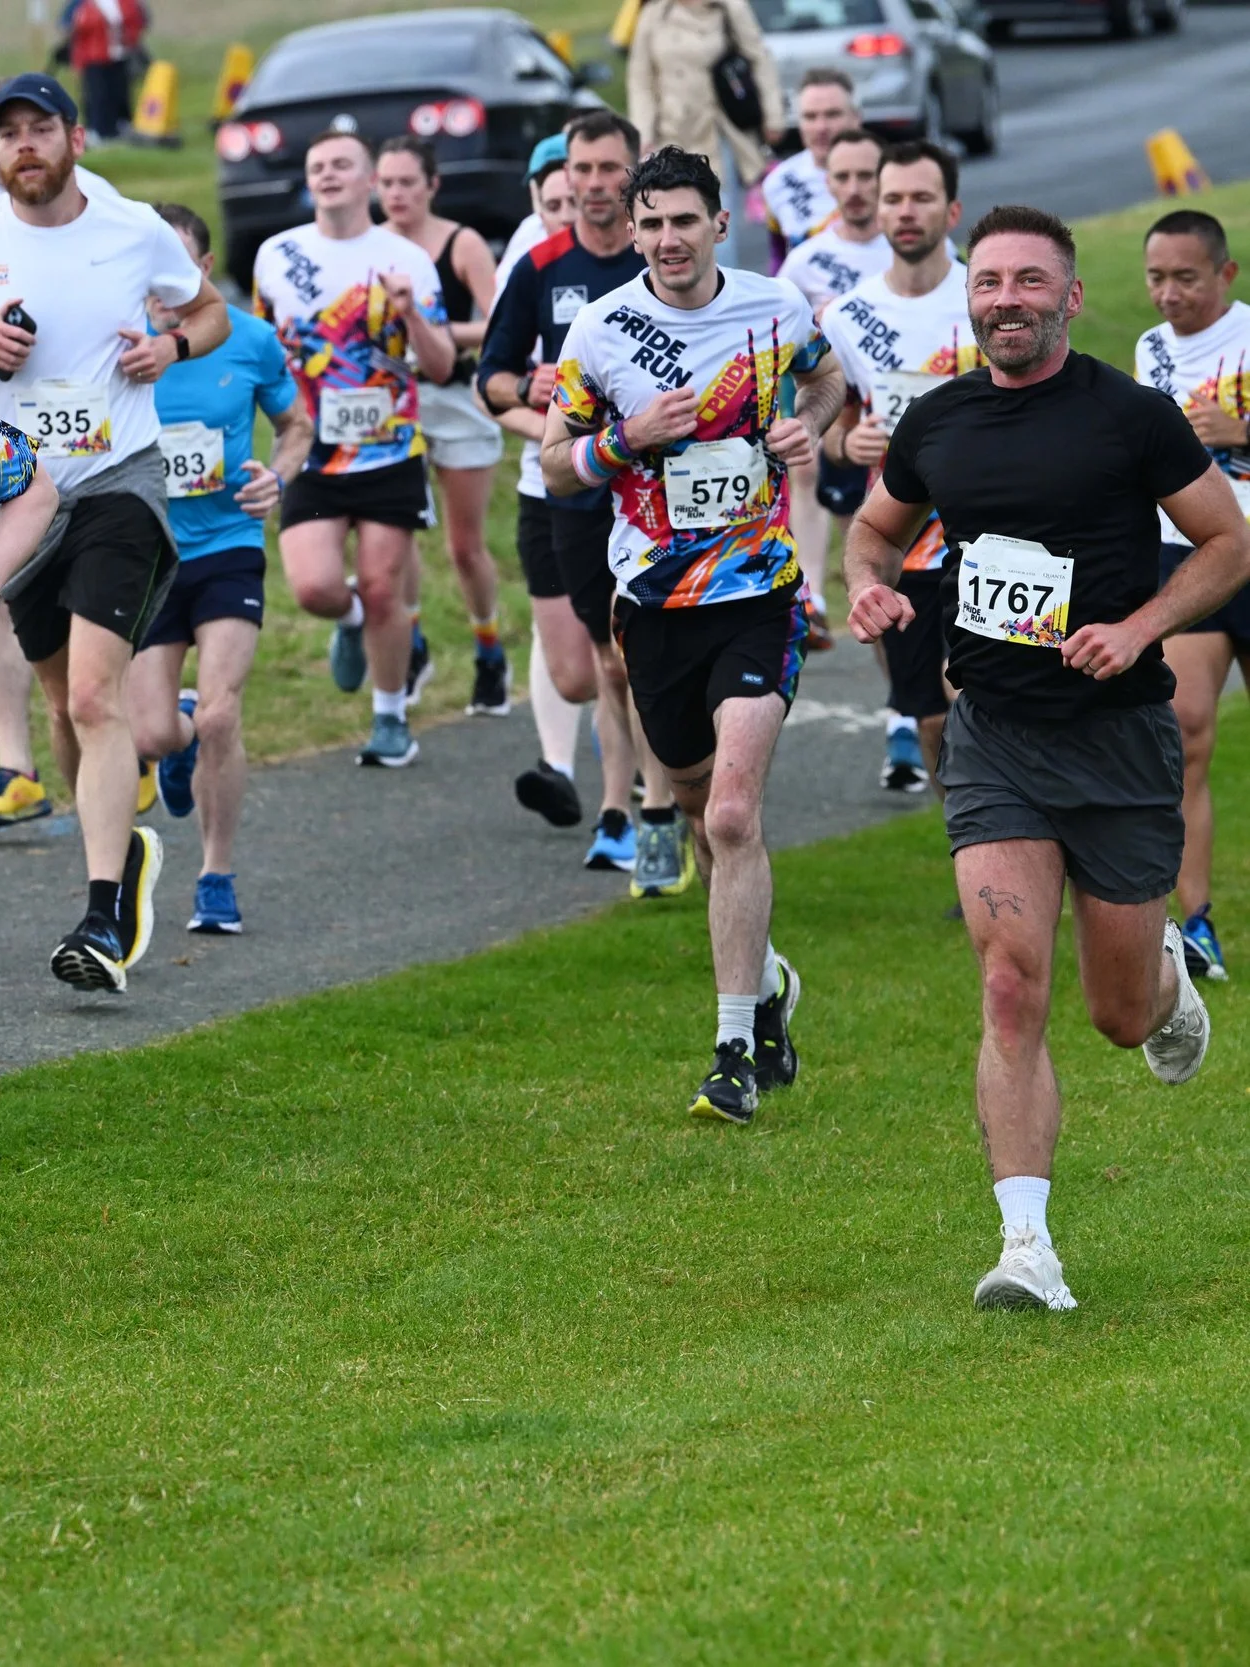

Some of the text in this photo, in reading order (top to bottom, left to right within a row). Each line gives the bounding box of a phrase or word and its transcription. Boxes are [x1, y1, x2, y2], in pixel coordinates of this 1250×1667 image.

[603, 310, 688, 362] PRIDE
[840, 301, 900, 346] PRIDE
[630, 346, 694, 389] RUN
[858, 335, 904, 370] RUN
[656, 382, 674, 393] 20
[709, 353, 750, 412] PRIDE
[38, 409, 91, 435] 335
[691, 475, 750, 505] 579
[963, 603, 981, 615] PRIDE
[968, 575, 1054, 617] 1767
[971, 614, 986, 624] RUN
